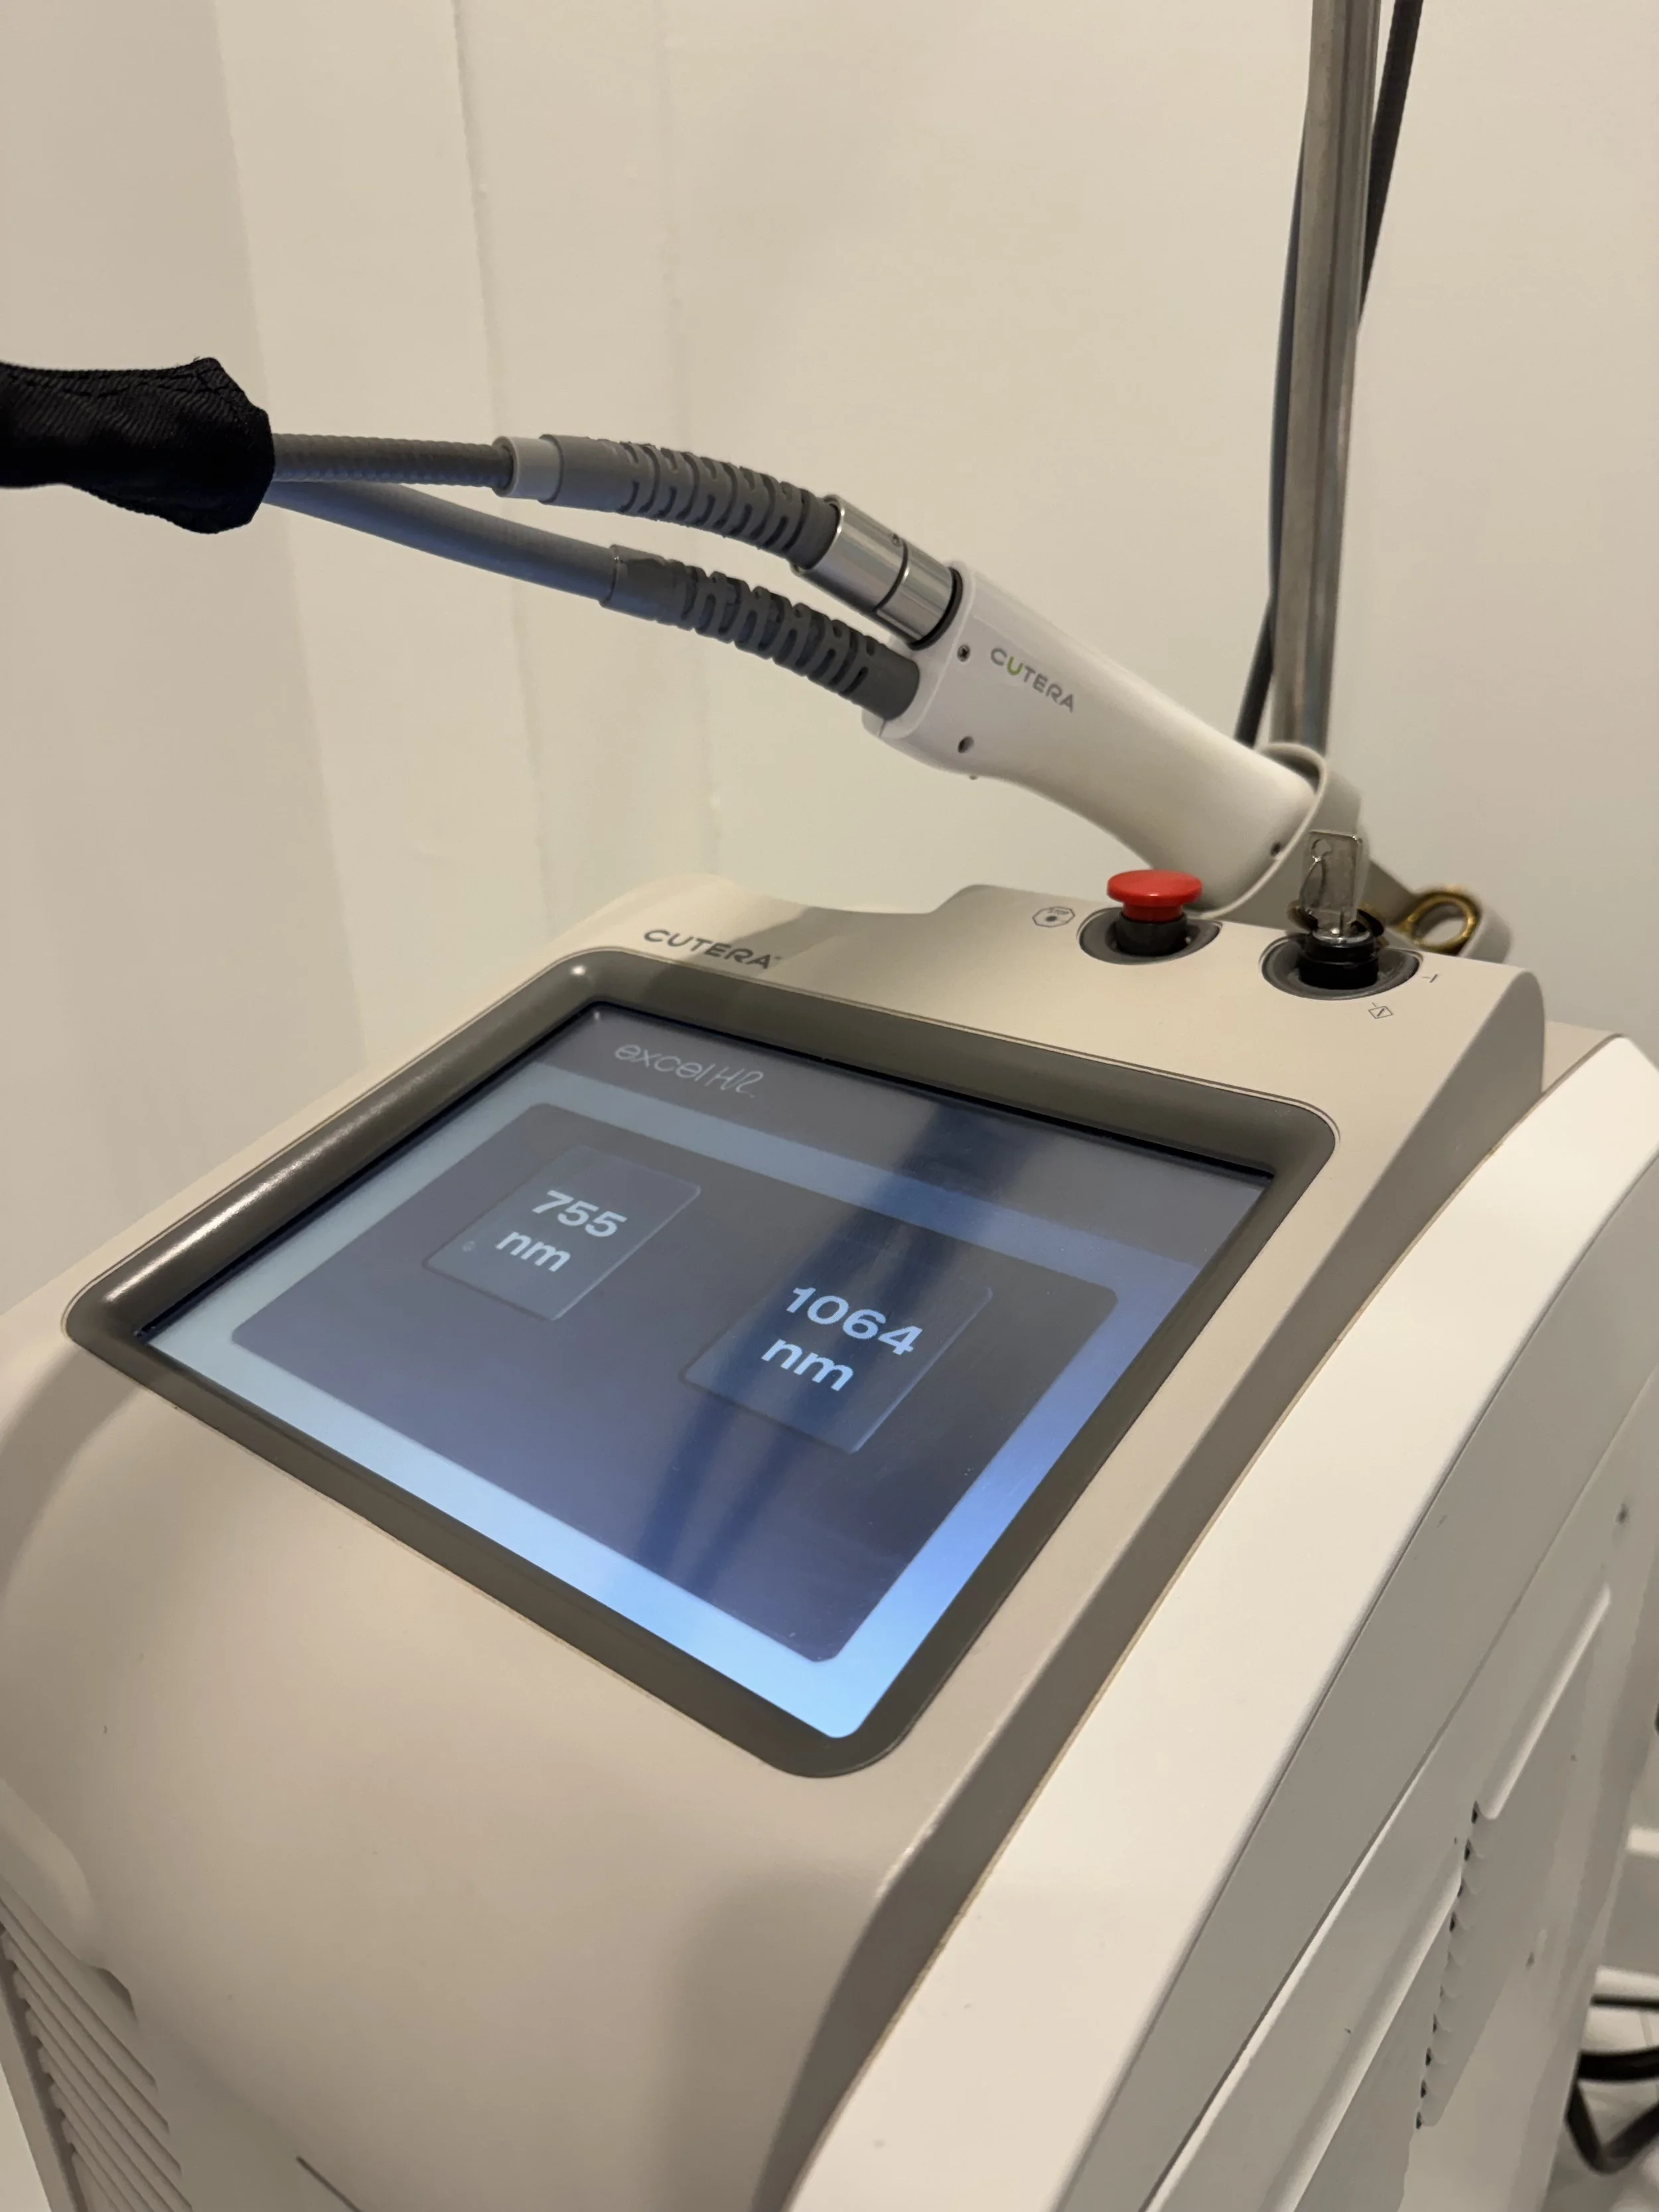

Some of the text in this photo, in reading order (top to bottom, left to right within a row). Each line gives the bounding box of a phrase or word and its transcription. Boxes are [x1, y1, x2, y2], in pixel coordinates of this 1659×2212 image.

[990, 648, 1074, 713] CUTERA
[532, 1189, 627, 1237] 755
[496, 1230, 571, 1272] nm
[786, 1287, 923, 1355] 1064
[761, 1339, 853, 1392] nm
